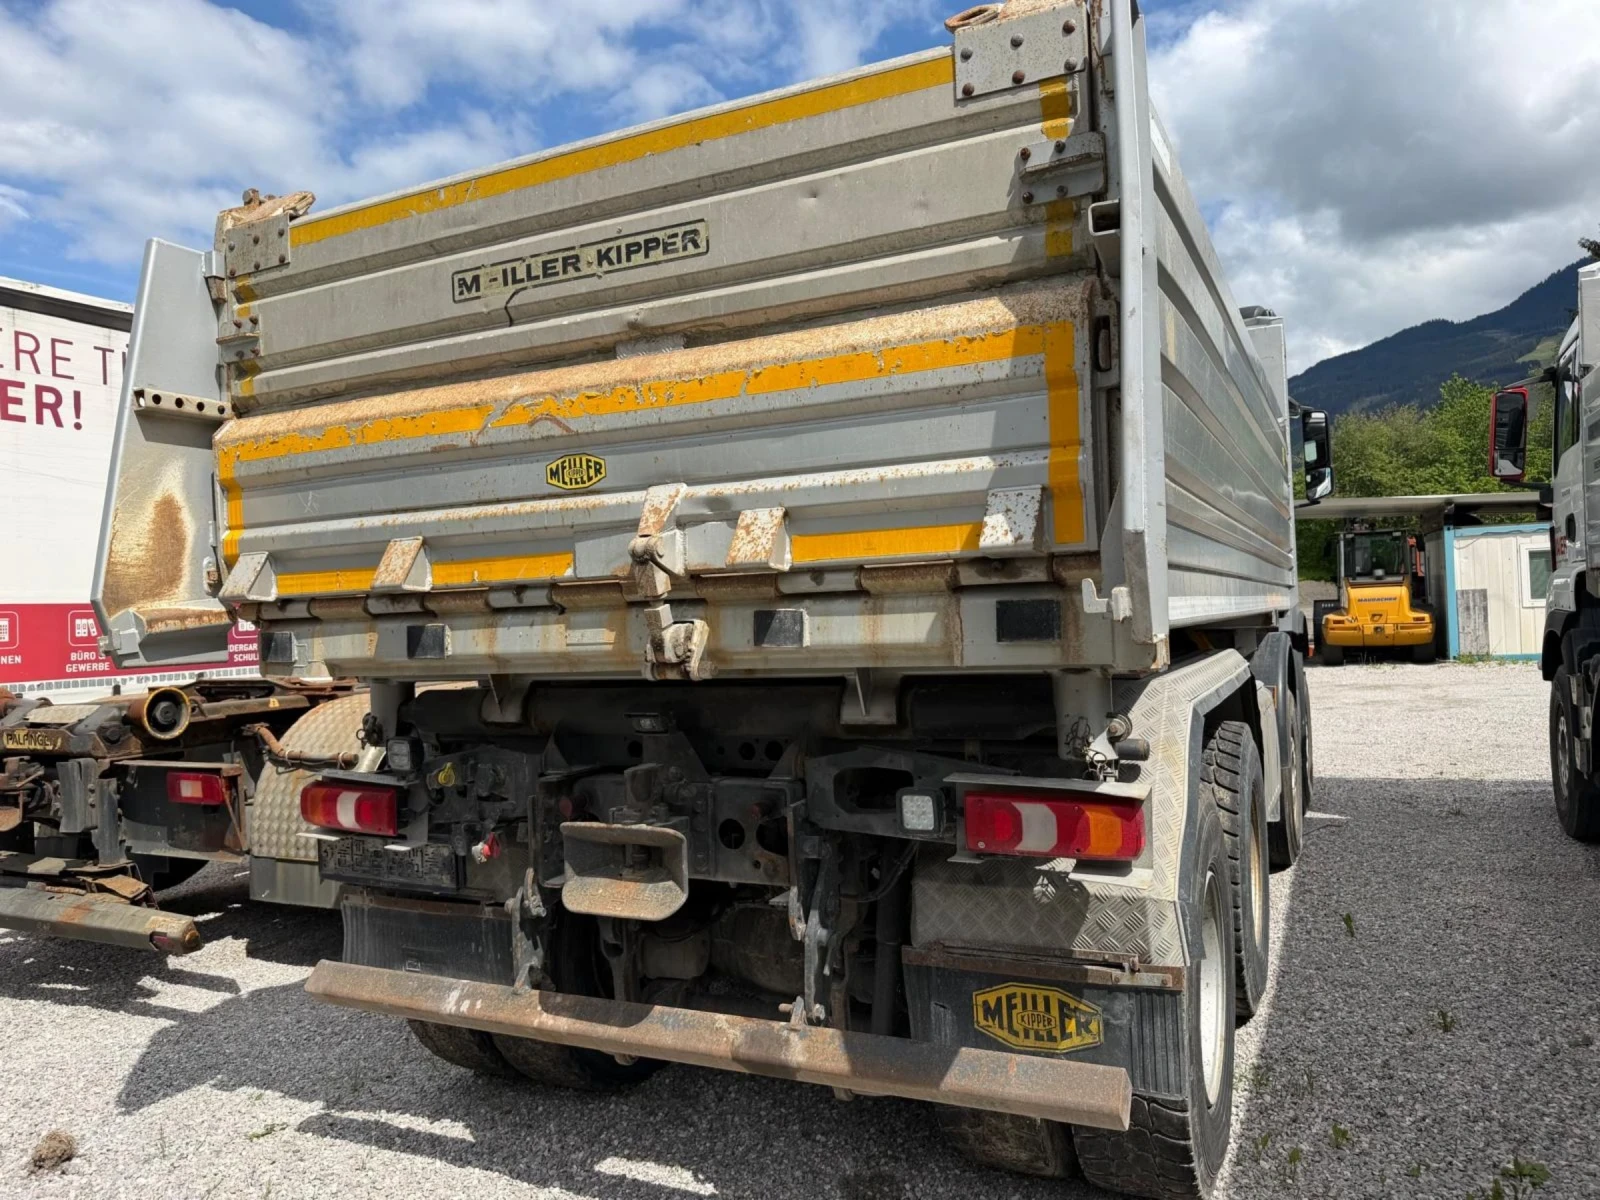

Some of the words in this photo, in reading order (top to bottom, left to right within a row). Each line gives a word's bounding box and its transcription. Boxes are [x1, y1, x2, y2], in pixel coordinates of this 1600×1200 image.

[457, 253, 581, 296] MILLER
[596, 227, 702, 269] KIPPER
[0, 327, 75, 381] RE
[549, 457, 604, 486] MEILLER
[65, 662, 110, 673] GEWERBE
[70, 650, 97, 661] BÜRO
[982, 992, 1096, 1043] MEILLER
[1020, 1013, 1053, 1028] KIPPER
